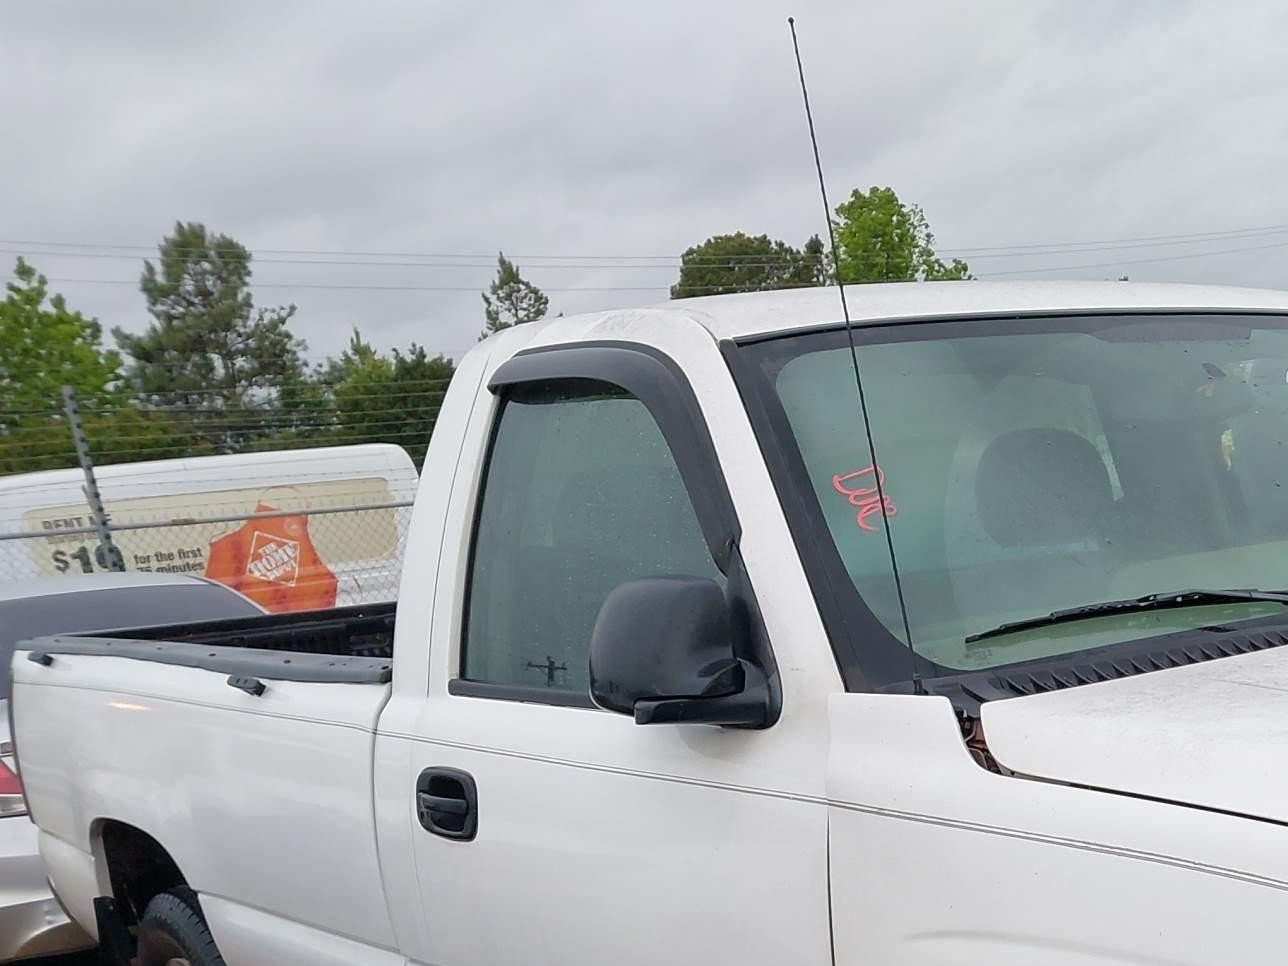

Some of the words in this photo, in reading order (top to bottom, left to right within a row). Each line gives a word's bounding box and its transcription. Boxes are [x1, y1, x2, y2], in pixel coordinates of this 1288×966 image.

[134, 554, 151, 564] for
[155, 551, 174, 562] the
[178, 548, 203, 560] first
